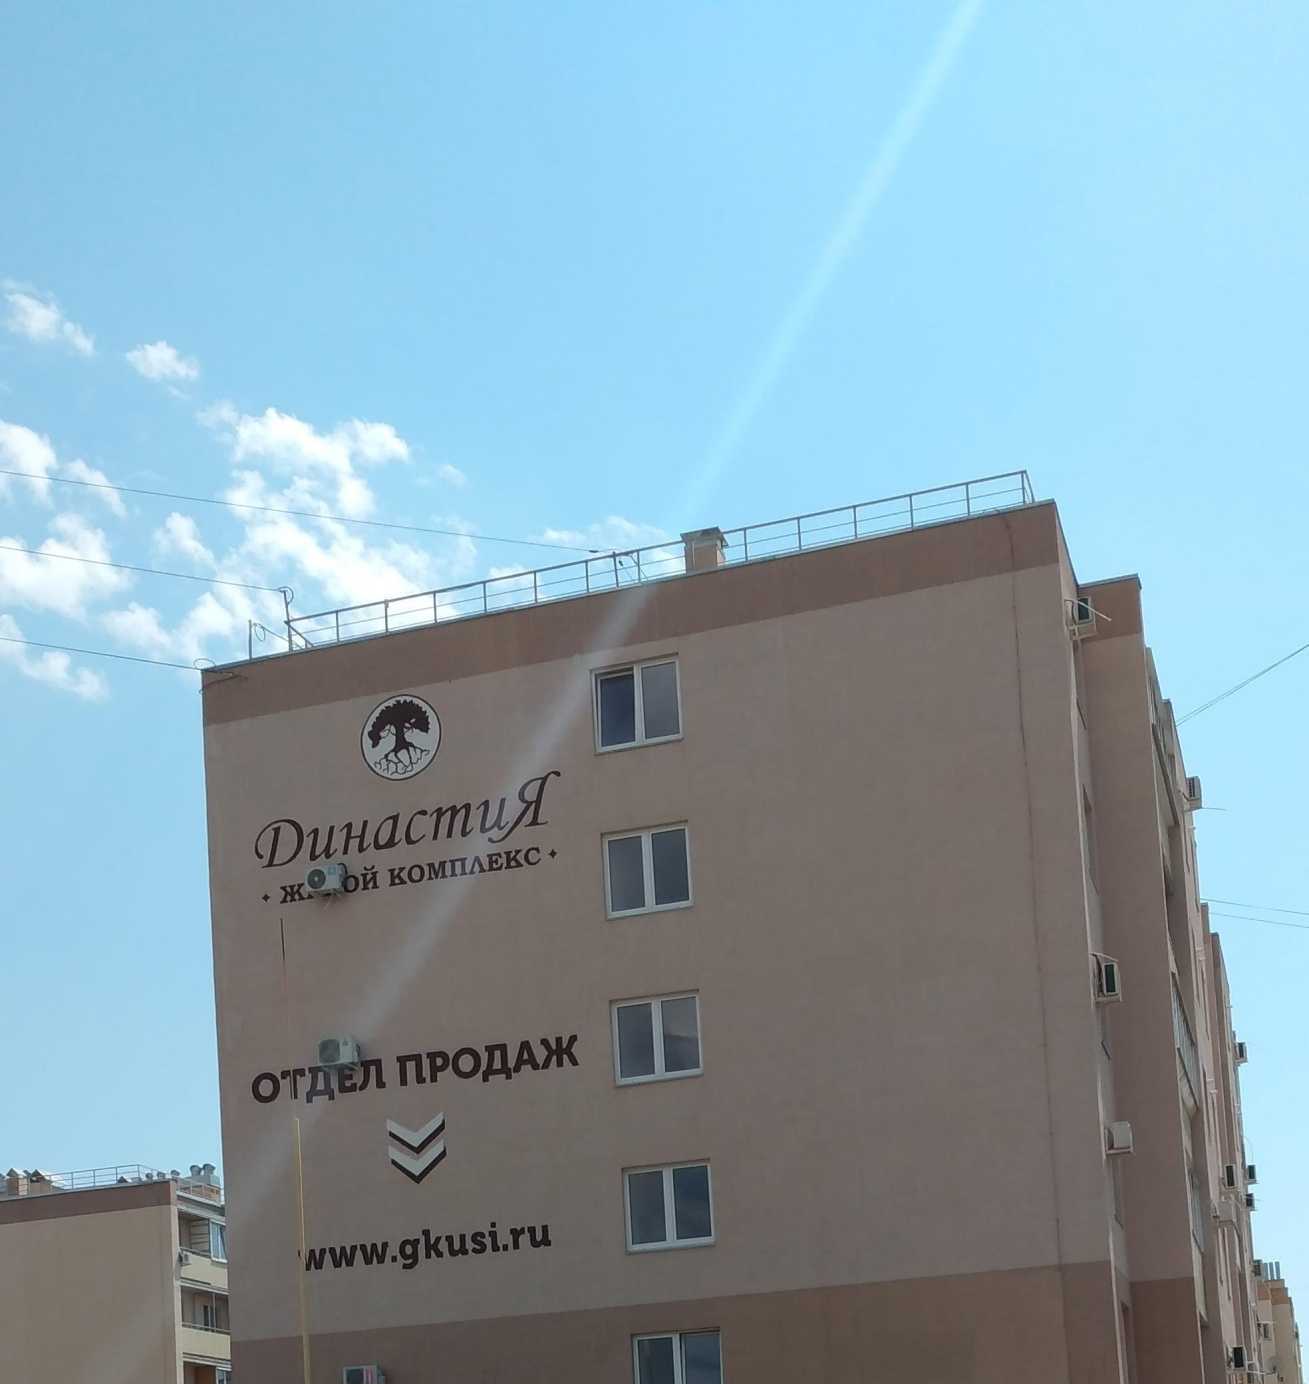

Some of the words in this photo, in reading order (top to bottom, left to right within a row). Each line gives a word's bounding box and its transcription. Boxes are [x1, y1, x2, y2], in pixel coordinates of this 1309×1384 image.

[279, 865, 380, 904] ЖОЙ
[387, 847, 543, 888] КОМПЛЕКС
[251, 1058, 386, 1104] ОТДЕЛ
[396, 1034, 581, 1087] ПРОДАЖ
[297, 1222, 552, 1272] www.gkusi.ru
